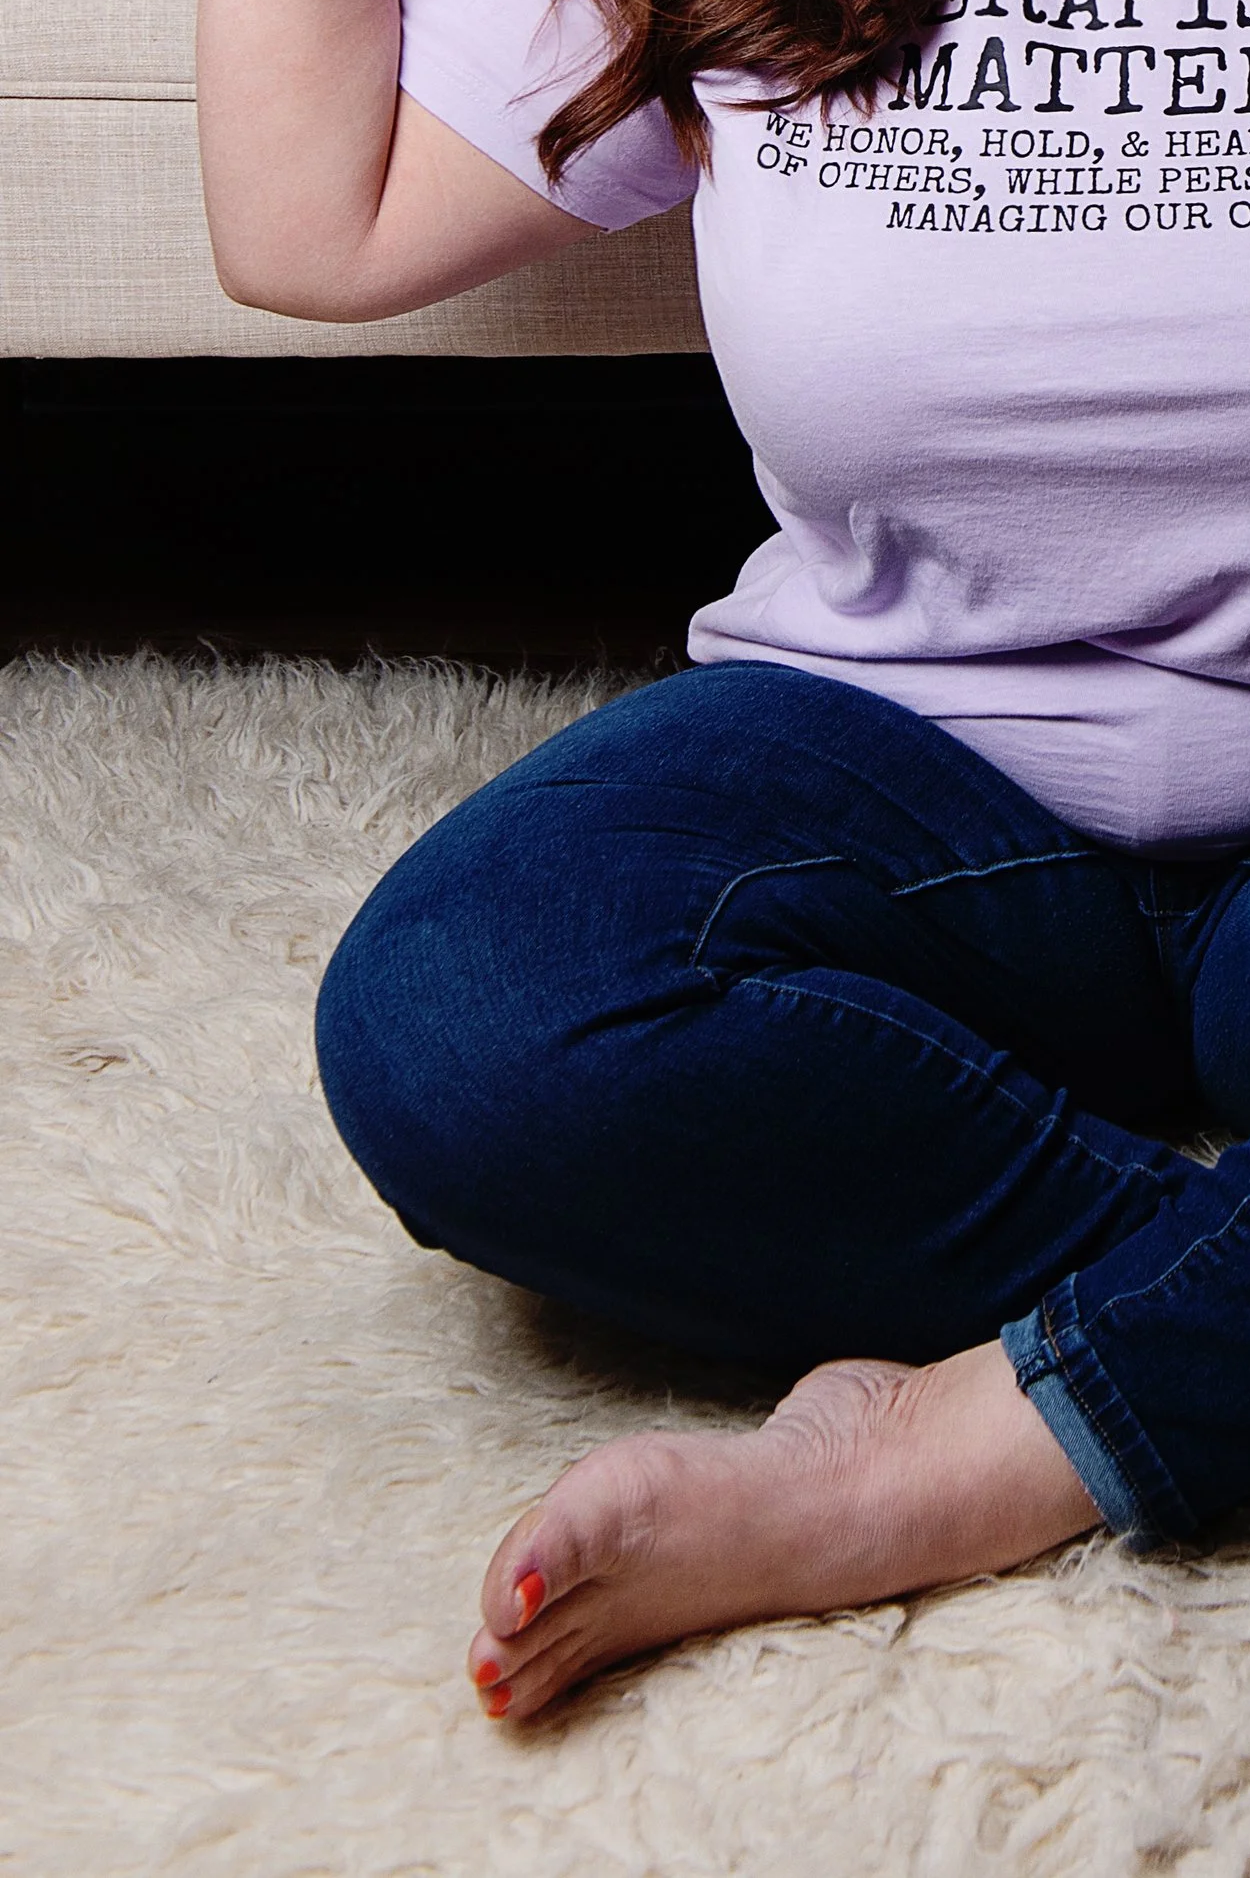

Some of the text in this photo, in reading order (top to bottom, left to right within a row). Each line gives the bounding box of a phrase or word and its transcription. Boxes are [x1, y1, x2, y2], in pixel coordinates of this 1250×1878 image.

[765, 111, 813, 149] WE
[823, 123, 963, 163] HONOR,
[979, 129, 1105, 164] HOLD,
[1121, 130, 1150, 158] &
[756, 142, 808, 177] OF
[818, 161, 986, 201] OTHERS,
[1005, 167, 1142, 196] WHILE
[886, 201, 1108, 233] MANAGING
[1125, 202, 1213, 232] OUR
